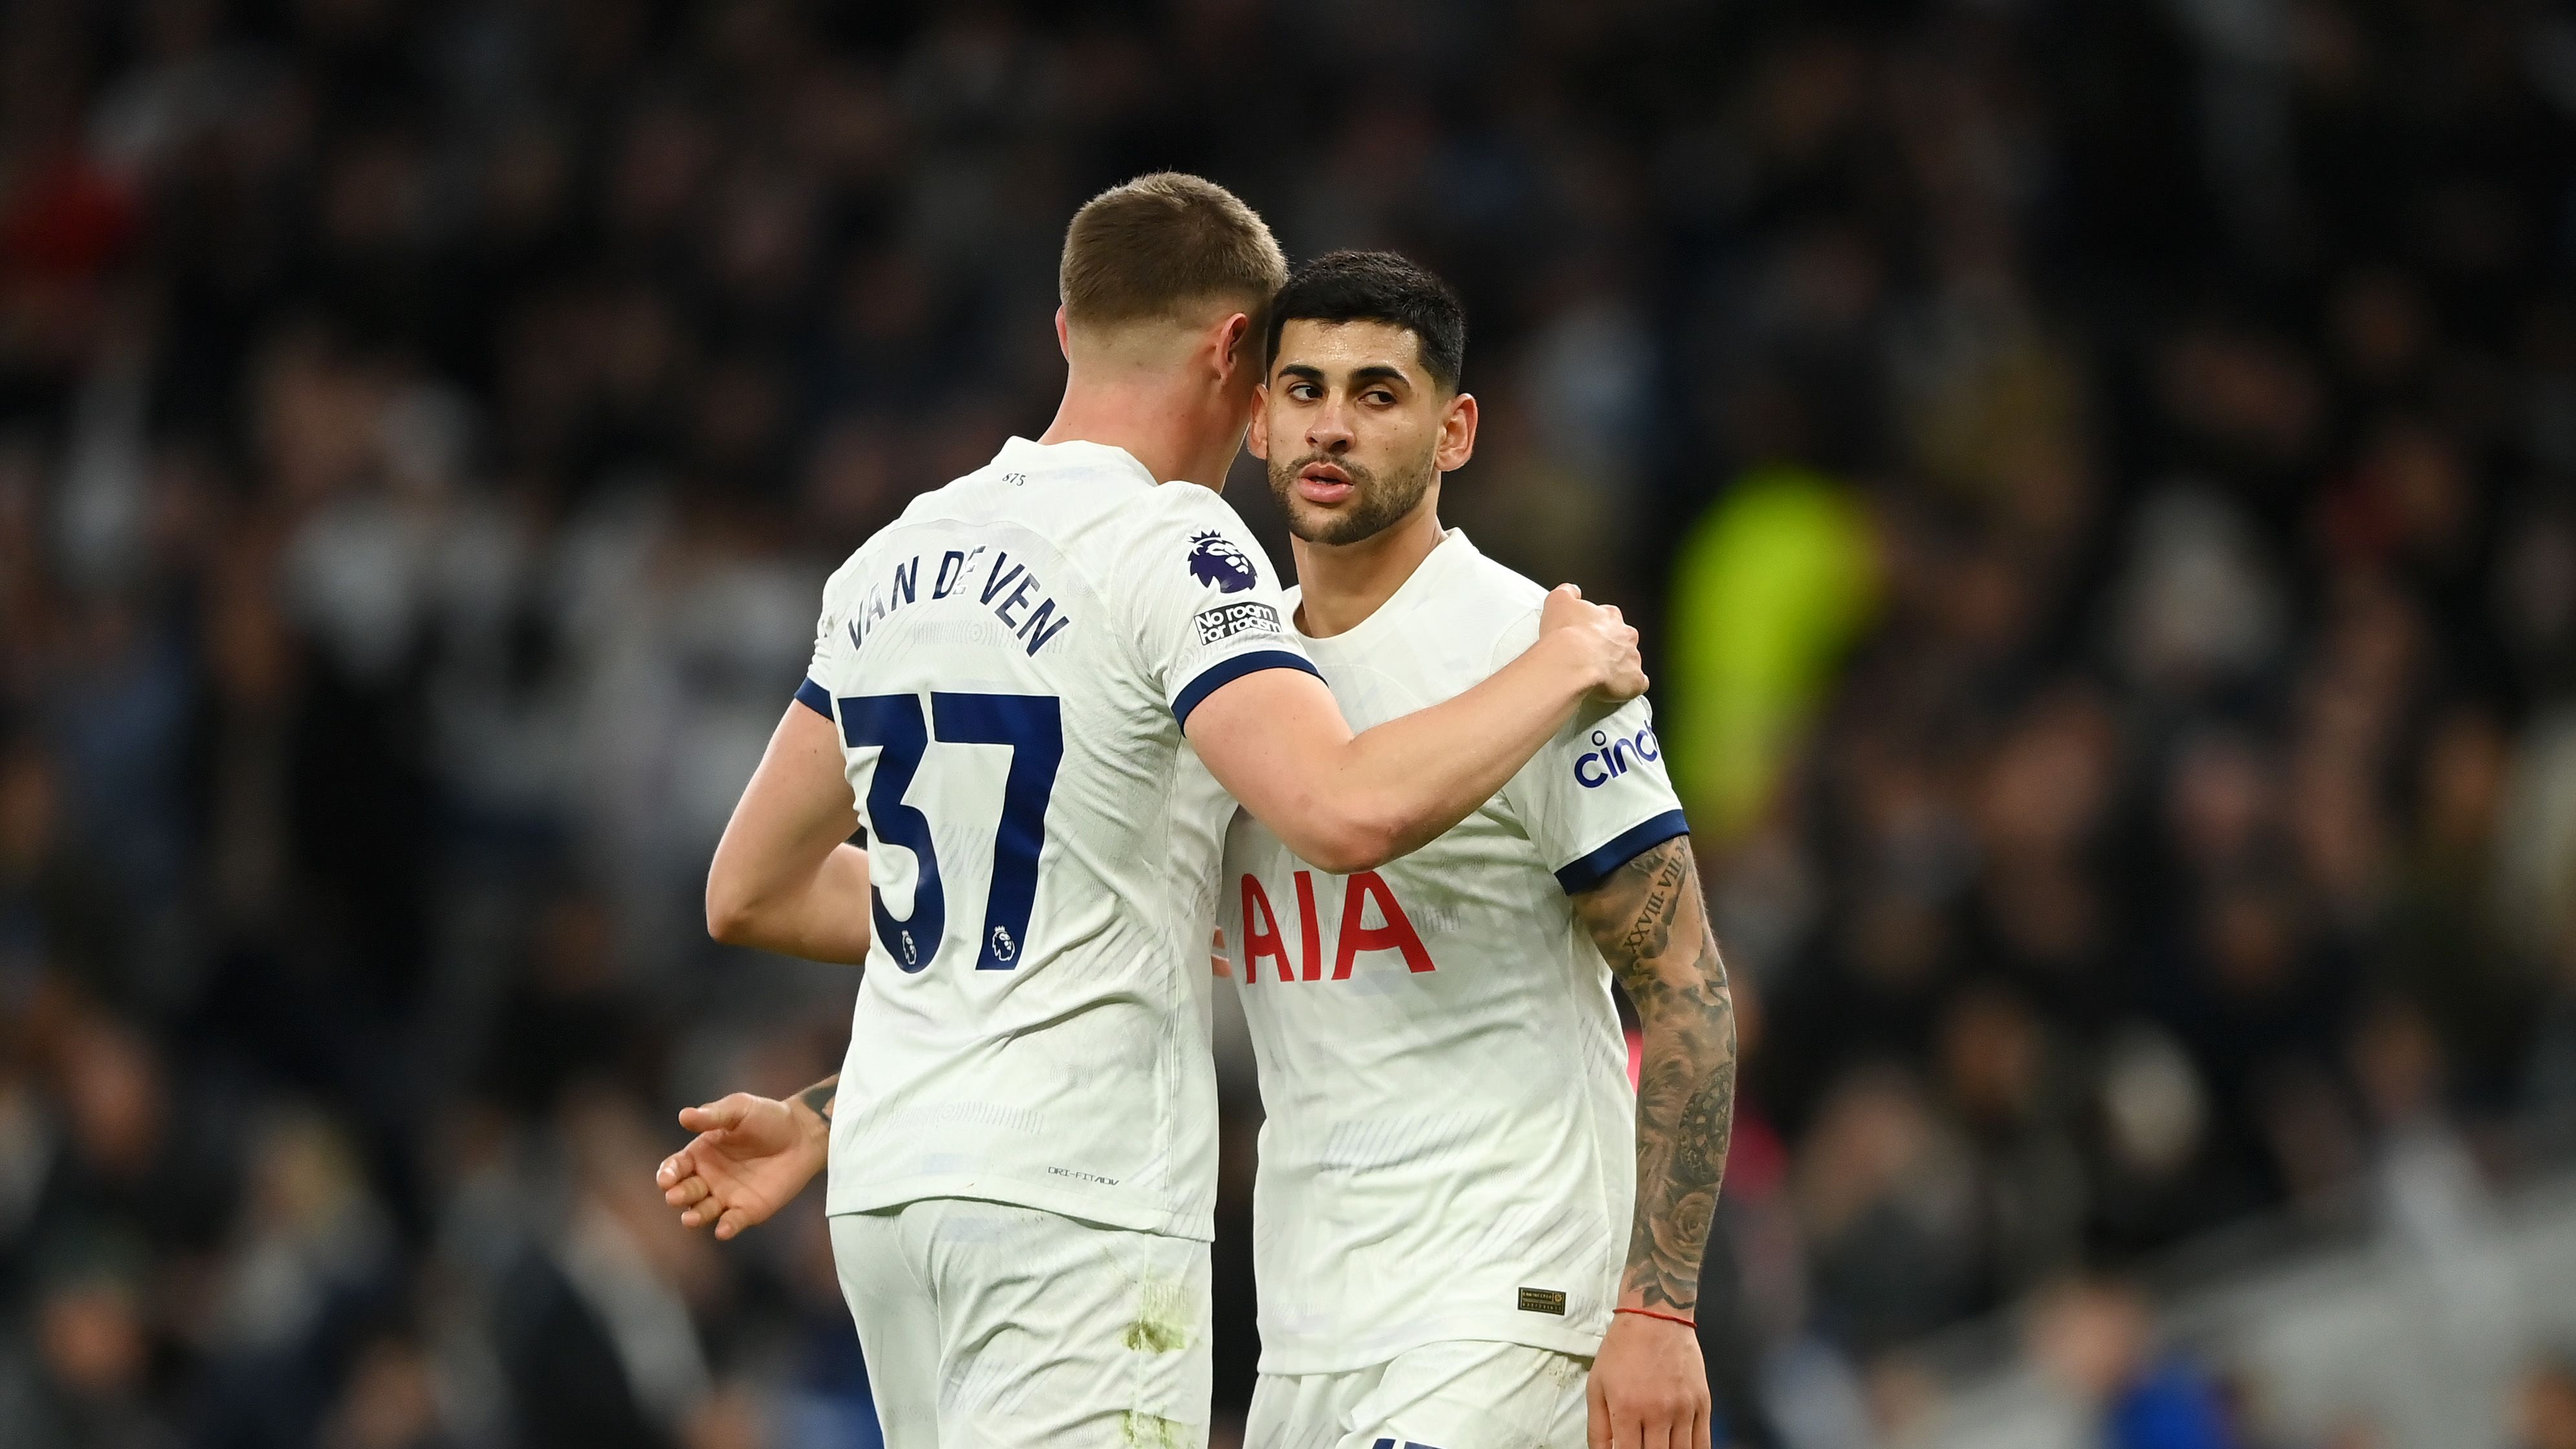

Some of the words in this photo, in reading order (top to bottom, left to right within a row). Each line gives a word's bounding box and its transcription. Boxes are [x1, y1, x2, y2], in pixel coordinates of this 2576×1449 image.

[1002, 473, 1026, 486] 875
[847, 555, 919, 651] VAN
[979, 551, 1070, 657] VEN
[1195, 611, 1224, 631] No
[1225, 604, 1274, 621] room
[1199, 624, 1226, 645] for
[1228, 616, 1281, 634] racism
[837, 692, 1064, 974] 37
[1241, 871, 1436, 984] AIA
